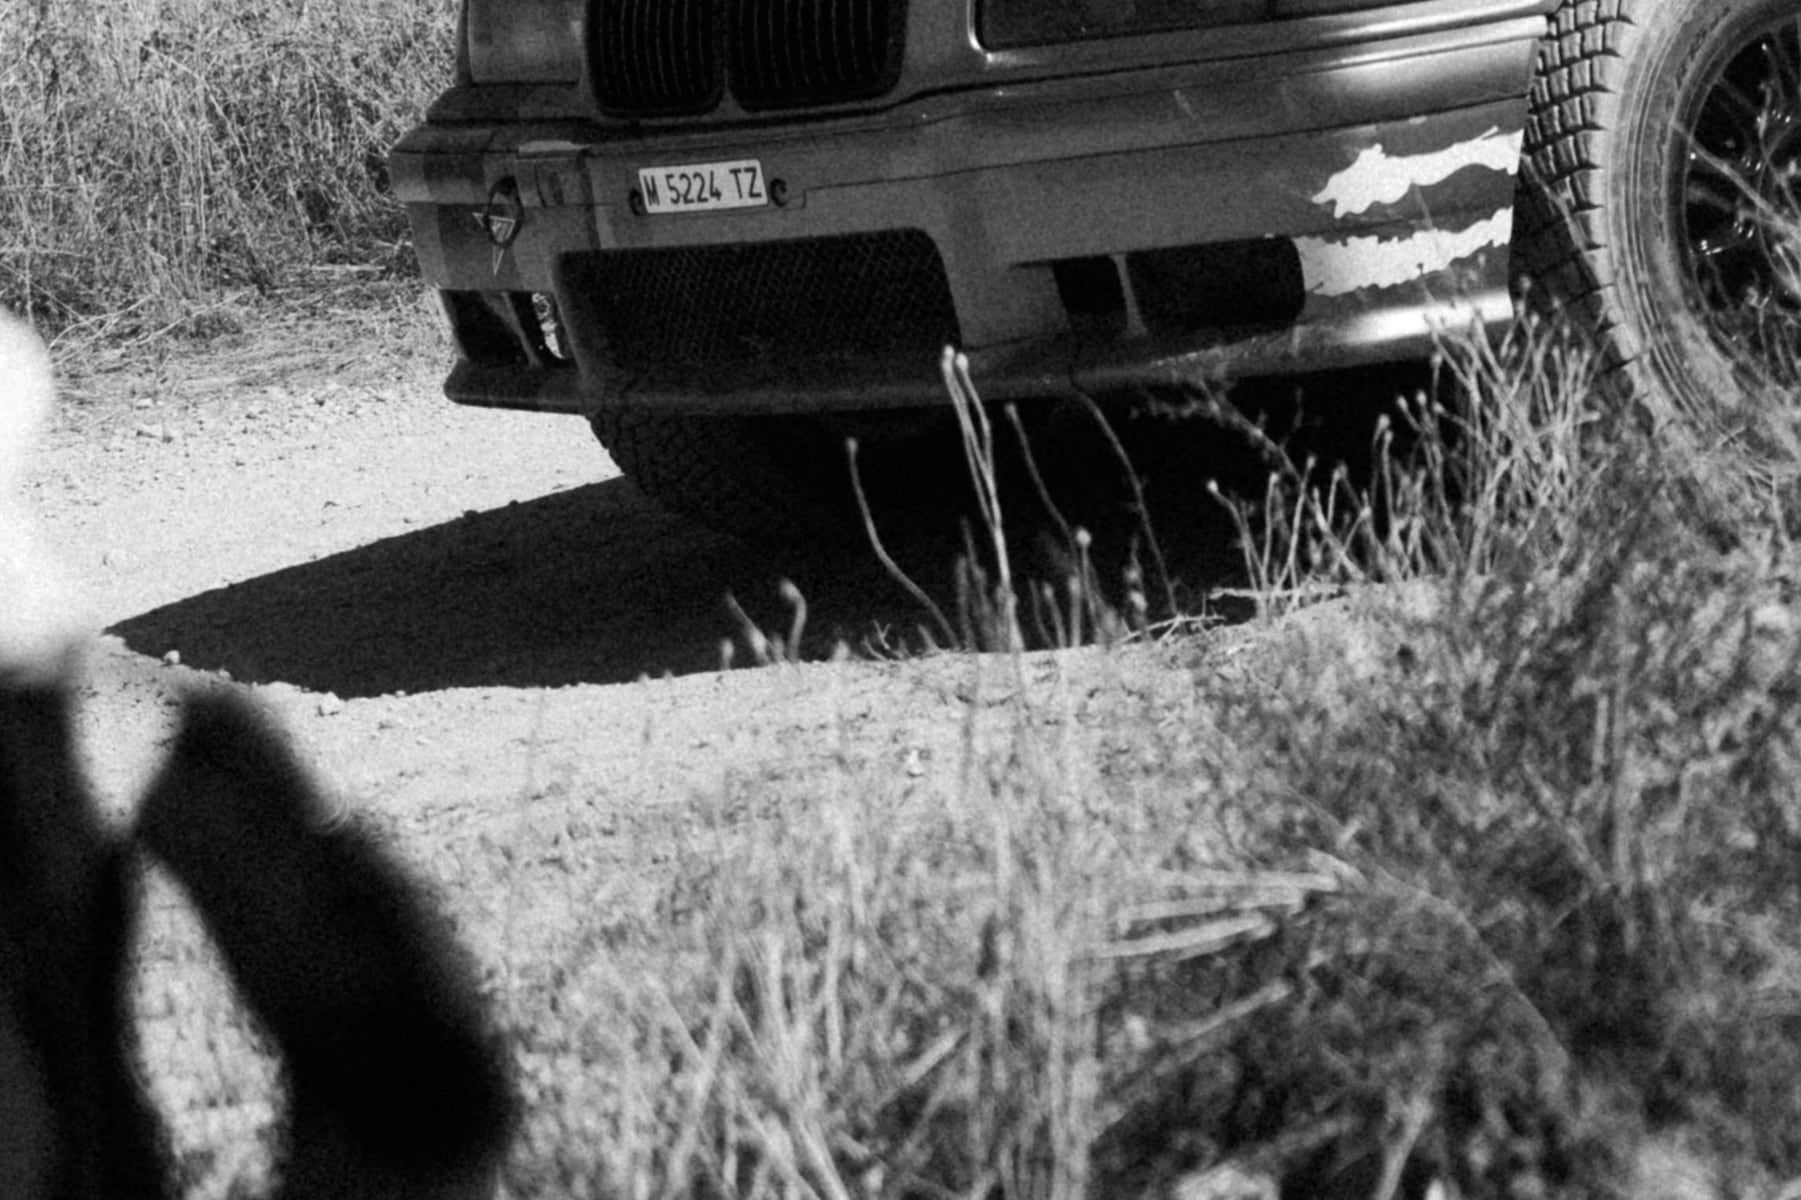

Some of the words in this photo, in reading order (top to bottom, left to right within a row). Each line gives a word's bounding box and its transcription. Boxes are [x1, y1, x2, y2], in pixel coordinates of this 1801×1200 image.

[643, 174, 661, 207] M
[665, 169, 722, 205] 5224
[729, 166, 763, 200] TZ
